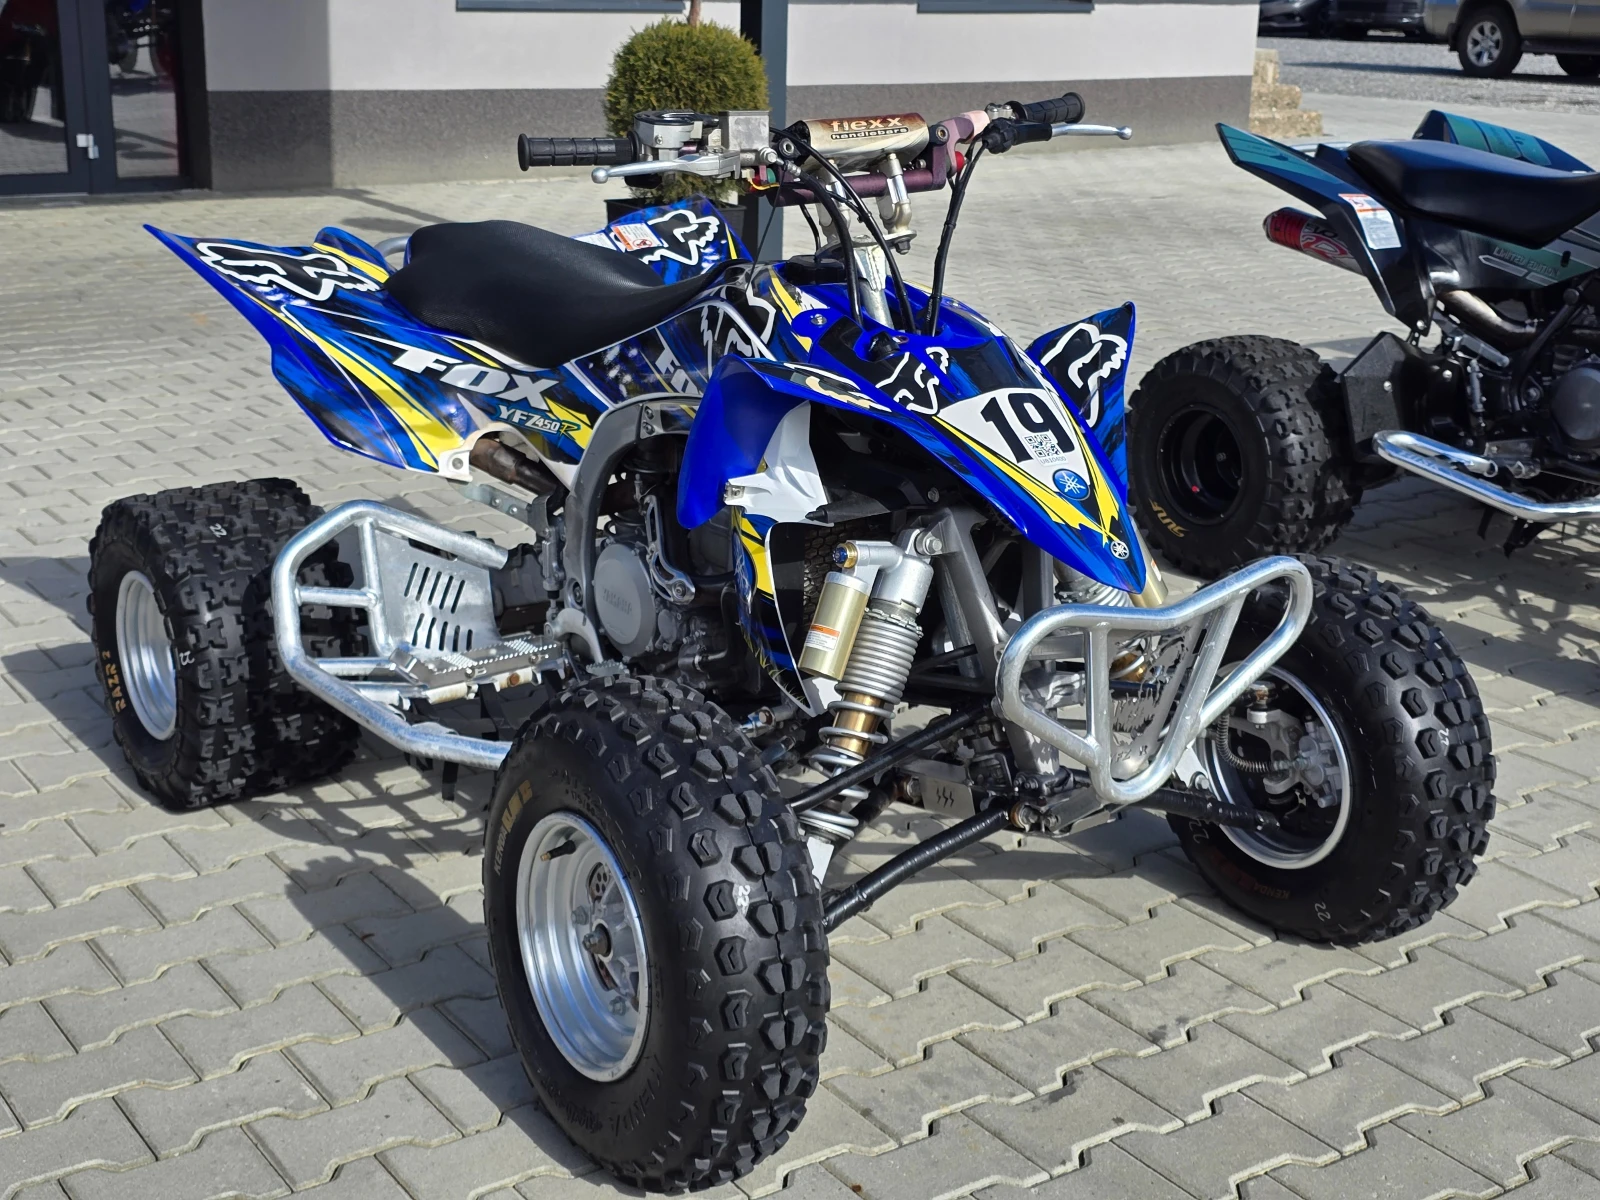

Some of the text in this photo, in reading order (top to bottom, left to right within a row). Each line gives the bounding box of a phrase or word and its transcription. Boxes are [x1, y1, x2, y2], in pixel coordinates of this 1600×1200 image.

[831, 127, 908, 140] handlebars
[392, 348, 560, 411] FOX
[980, 393, 1075, 464] 19
[493, 824, 509, 876] KENDA
[1314, 901, 1332, 922] 22
